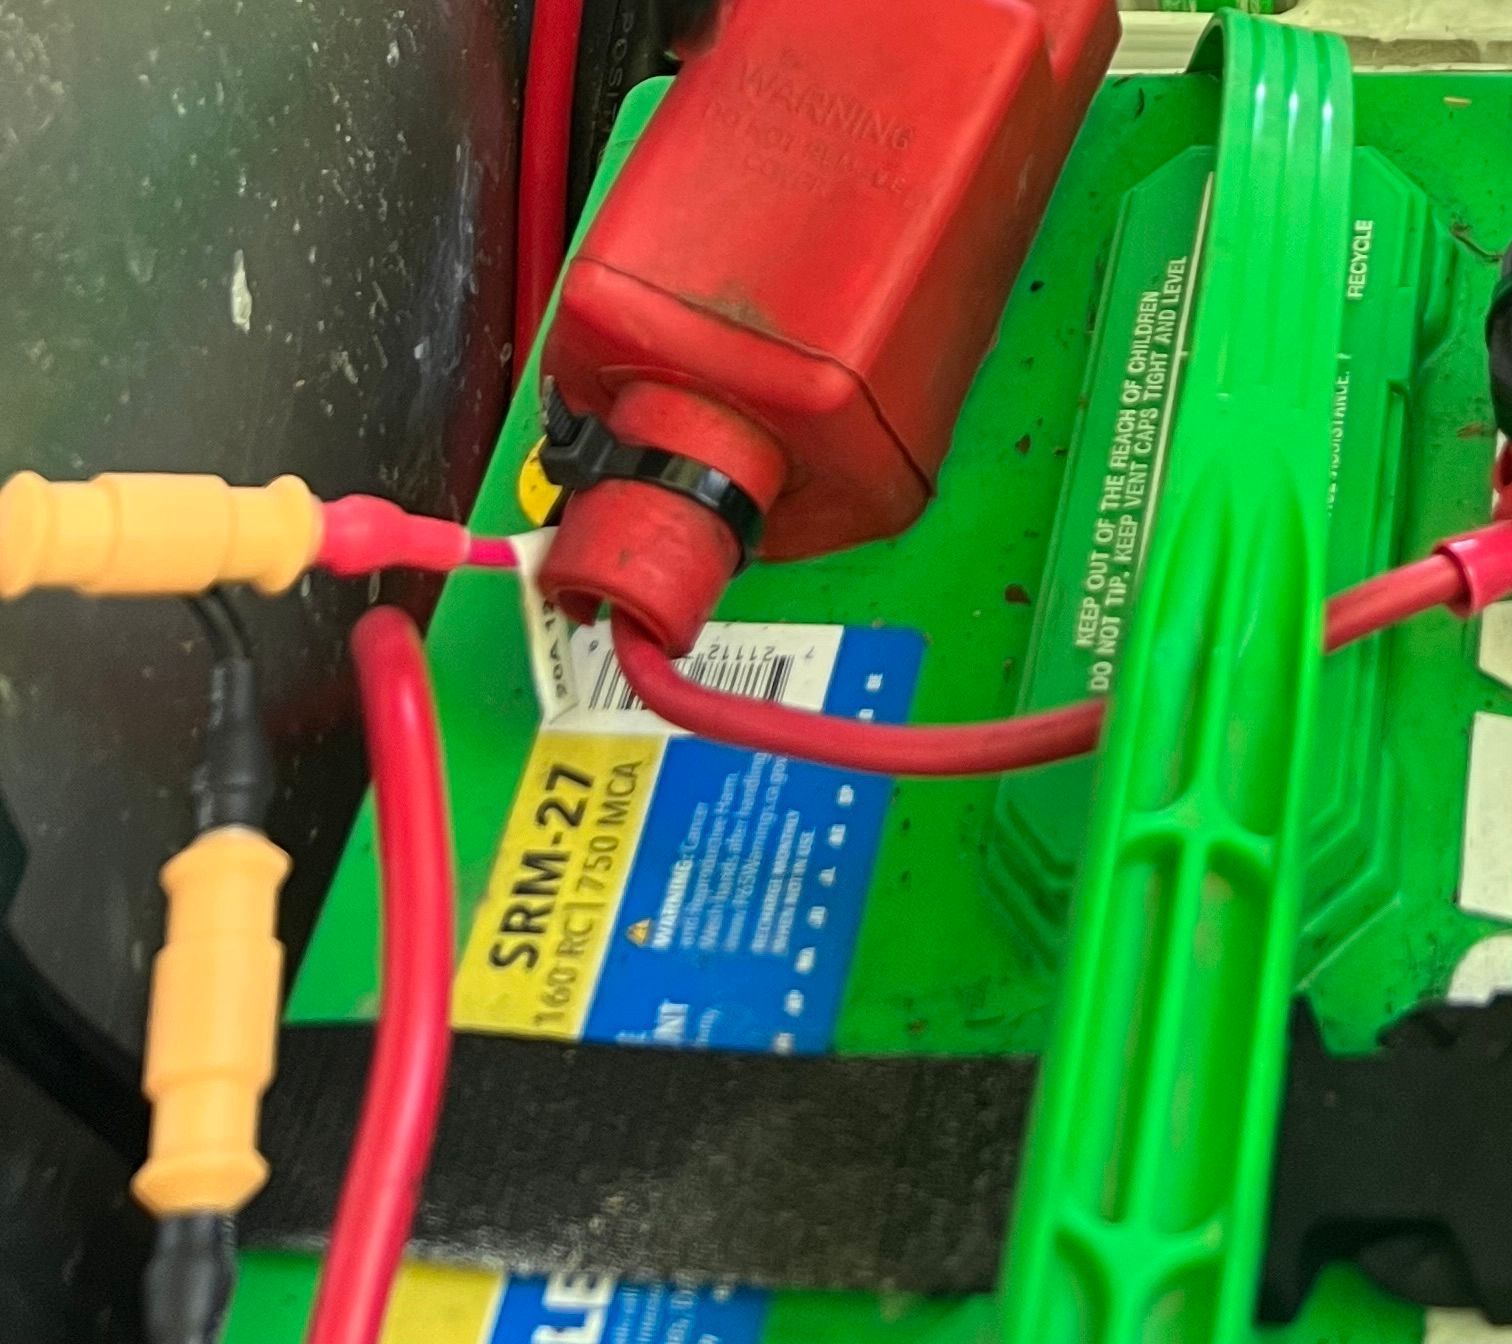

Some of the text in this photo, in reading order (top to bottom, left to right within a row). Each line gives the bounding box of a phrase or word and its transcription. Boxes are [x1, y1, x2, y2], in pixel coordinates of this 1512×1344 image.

[738, 59, 915, 153] WARNING
[1346, 219, 1374, 302] RECYCLE
[1076, 291, 1160, 647] KEEP OUT OF THE REACH OF CHILDREN
[1088, 255, 1188, 692] DO NOT TIP. KEEP VENT CAPS TIGHT AND LEVEL
[489, 763, 595, 974] SRM-27
[533, 759, 644, 1025] 160 RC 750 MCA
